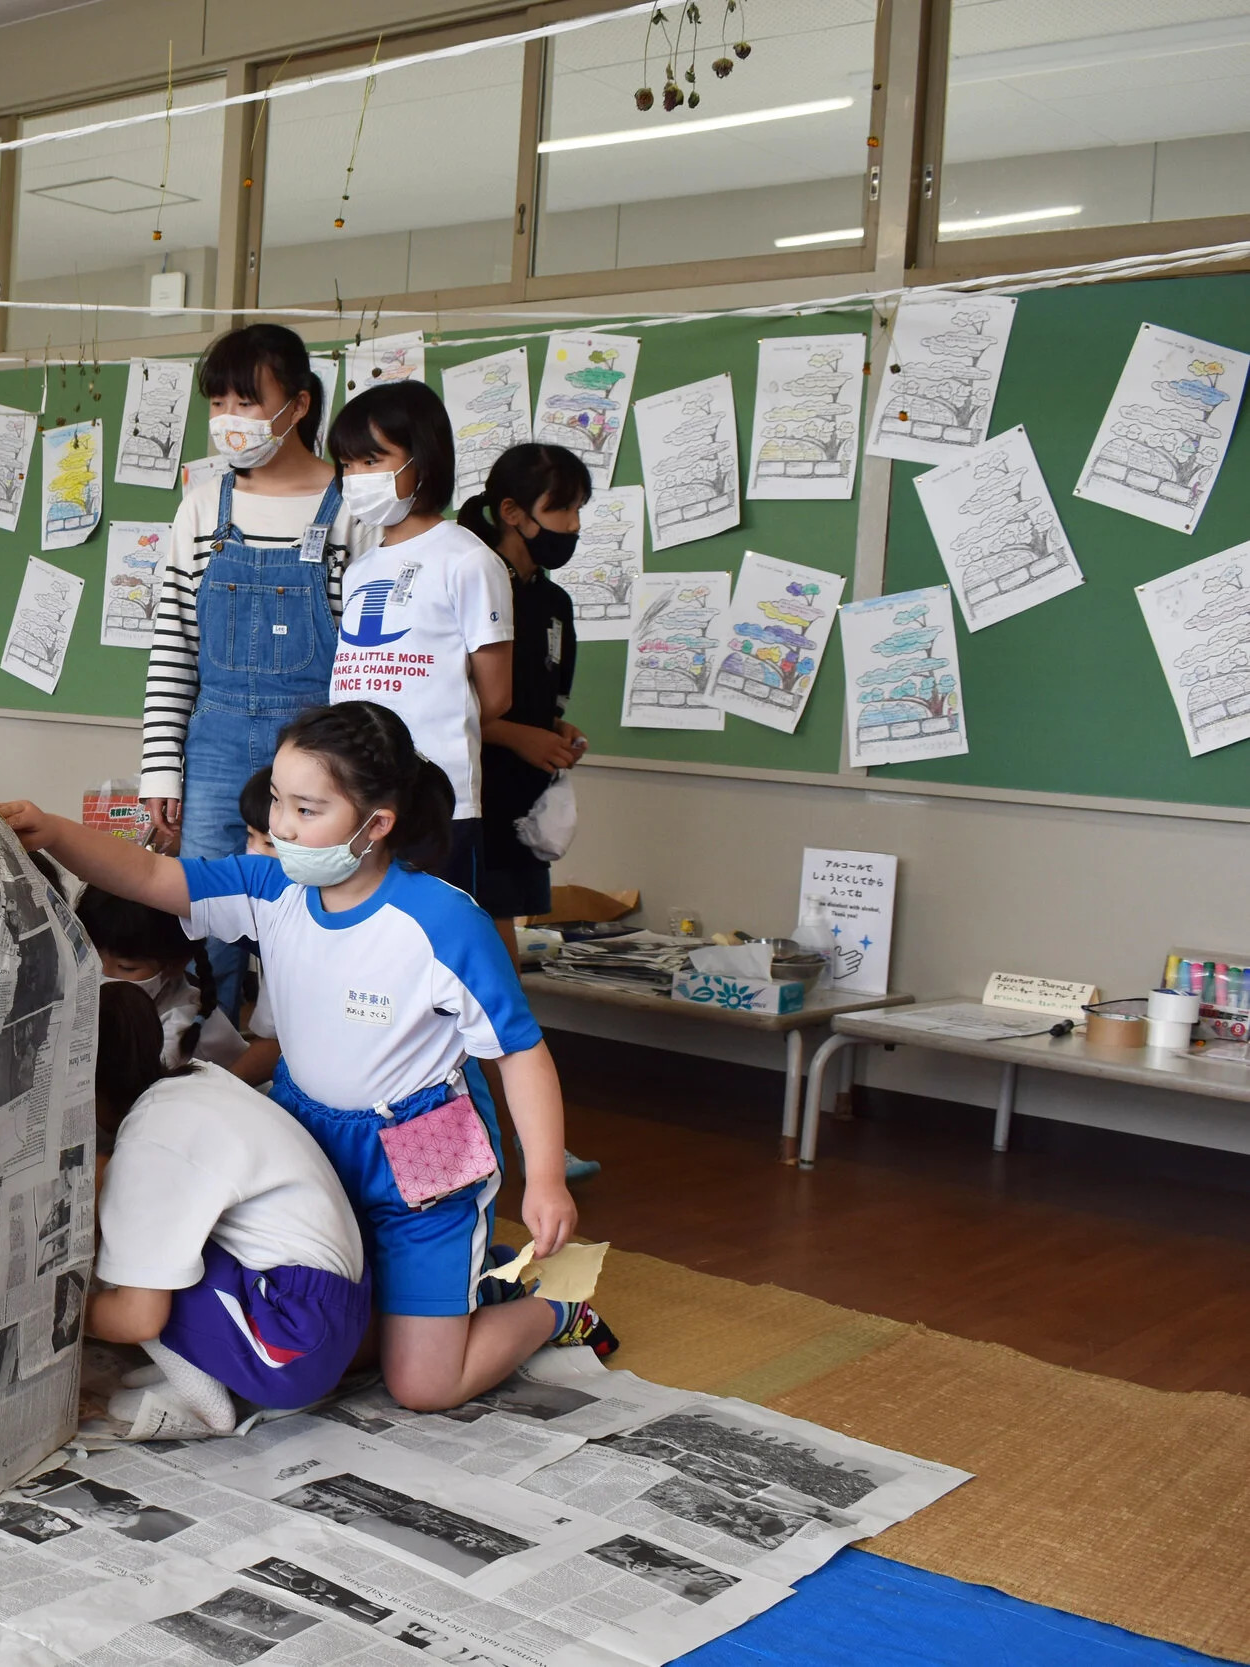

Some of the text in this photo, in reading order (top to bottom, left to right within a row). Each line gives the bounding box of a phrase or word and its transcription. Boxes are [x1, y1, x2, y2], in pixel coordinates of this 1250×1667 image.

[334, 652, 435, 664] KES A LITTLE MORE
[333, 665, 430, 677] MAKE A CHAMPION.
[334, 678, 402, 692] SINCE 1919
[825, 860, 874, 873] アルコールで
[812, 872, 884, 887] しょうどくしてから
[830, 886, 863, 898] 入ってね
[1037, 980, 1073, 992] Journal
[348, 990, 390, 1006] 取手東小
[339, 1572, 388, 1600] Salzburg
[402, 1599, 448, 1628] podium
[446, 1622, 468, 1635] the
[470, 1632, 500, 1651] takes
